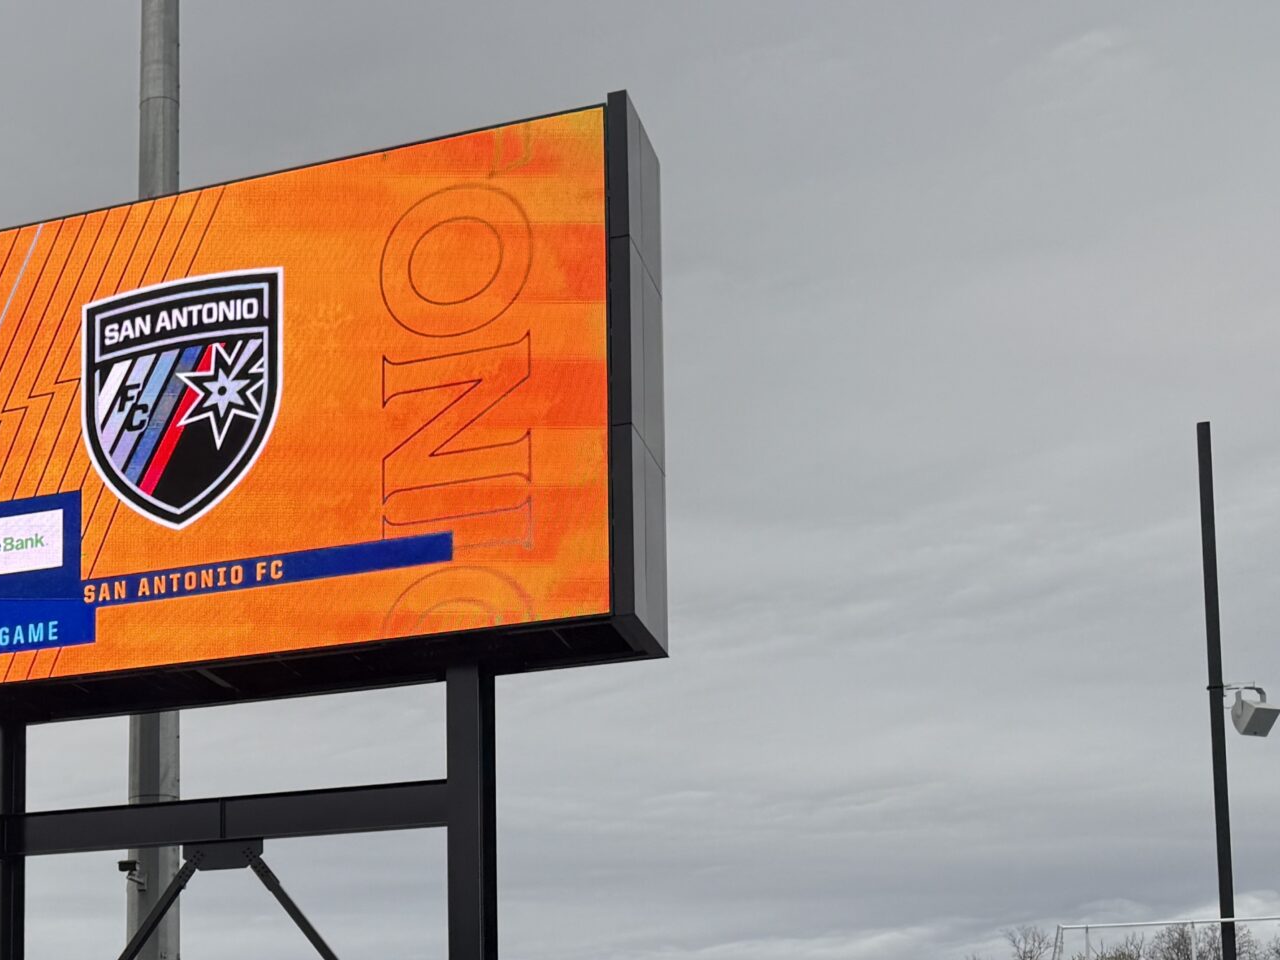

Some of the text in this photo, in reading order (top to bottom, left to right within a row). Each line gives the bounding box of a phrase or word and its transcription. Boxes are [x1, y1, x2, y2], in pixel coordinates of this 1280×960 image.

[104, 297, 259, 346] SAN ANTONIO
[83, 559, 284, 604] SAN ANTONIO FC
